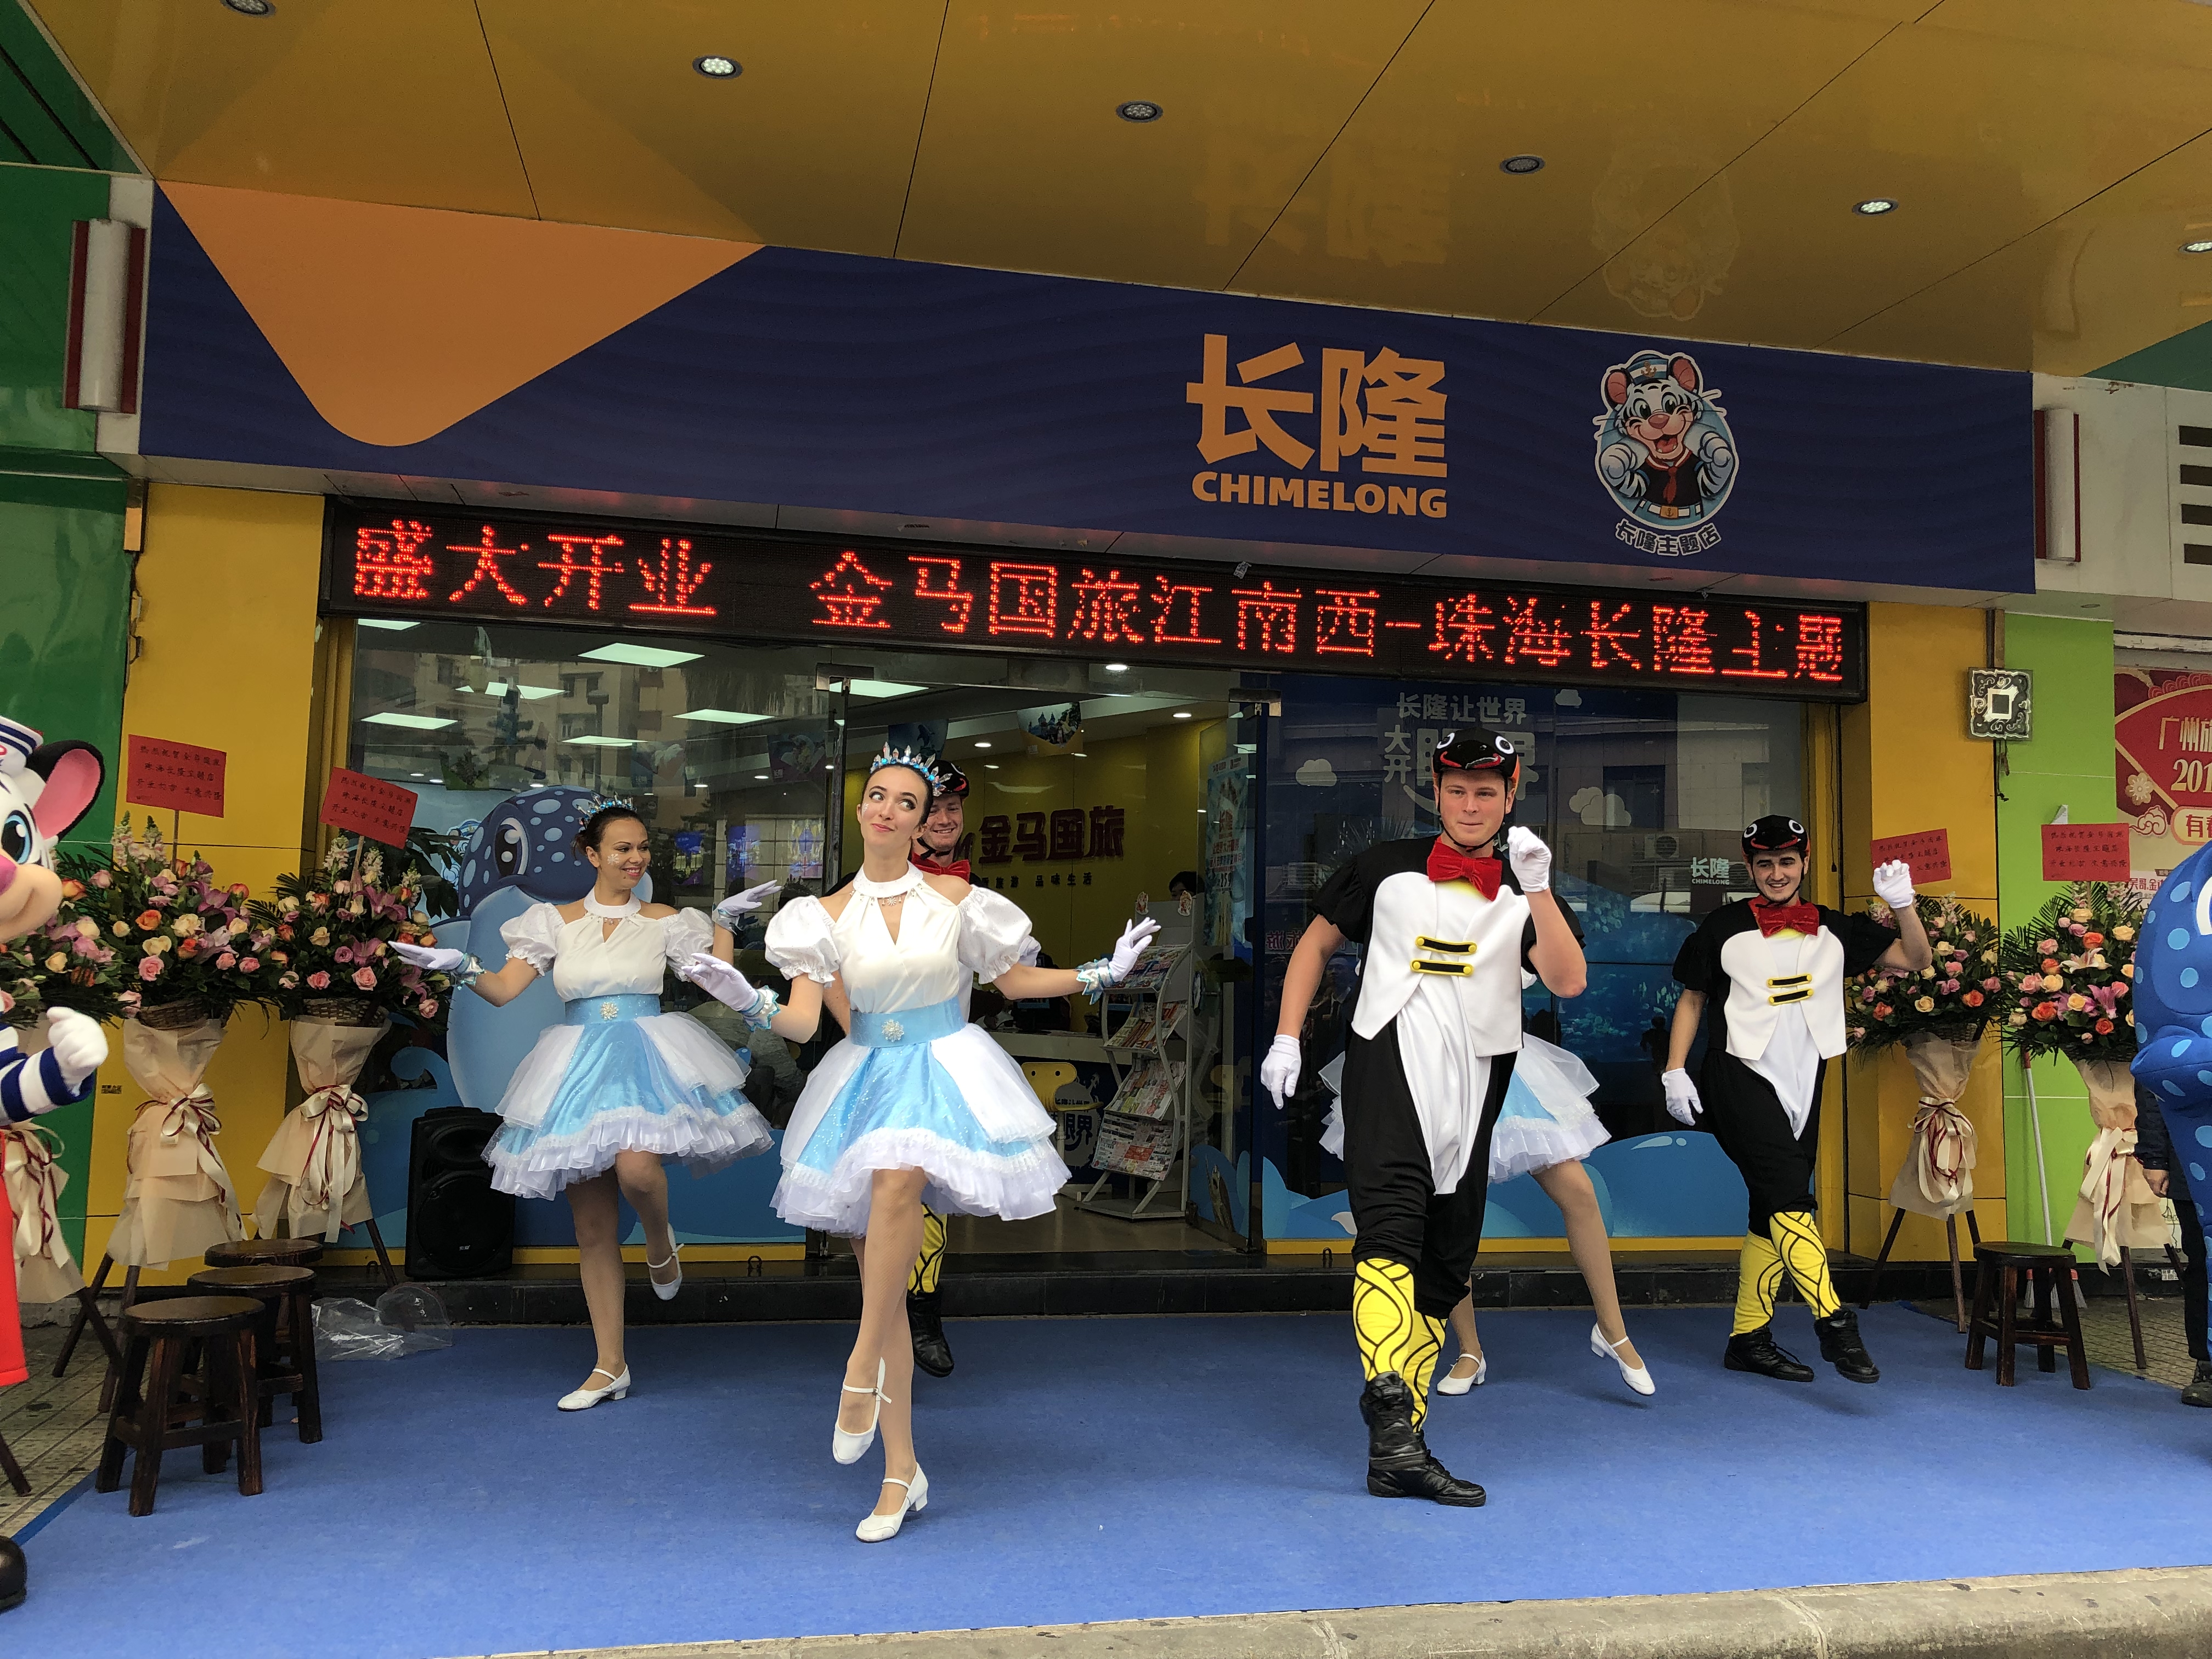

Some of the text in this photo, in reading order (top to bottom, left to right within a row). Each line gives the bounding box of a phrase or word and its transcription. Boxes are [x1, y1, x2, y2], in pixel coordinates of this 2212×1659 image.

[1186, 333, 1447, 477] 长隆
[1192, 471, 1447, 518] CHIMELONG
[1615, 518, 1722, 556] 长隆主题店
[354, 519, 716, 615] 盛大开业
[1397, 692, 1527, 725] 长隆让世界
[978, 805, 1125, 864] 金马国旅
[1690, 857, 1729, 878] 长隆
